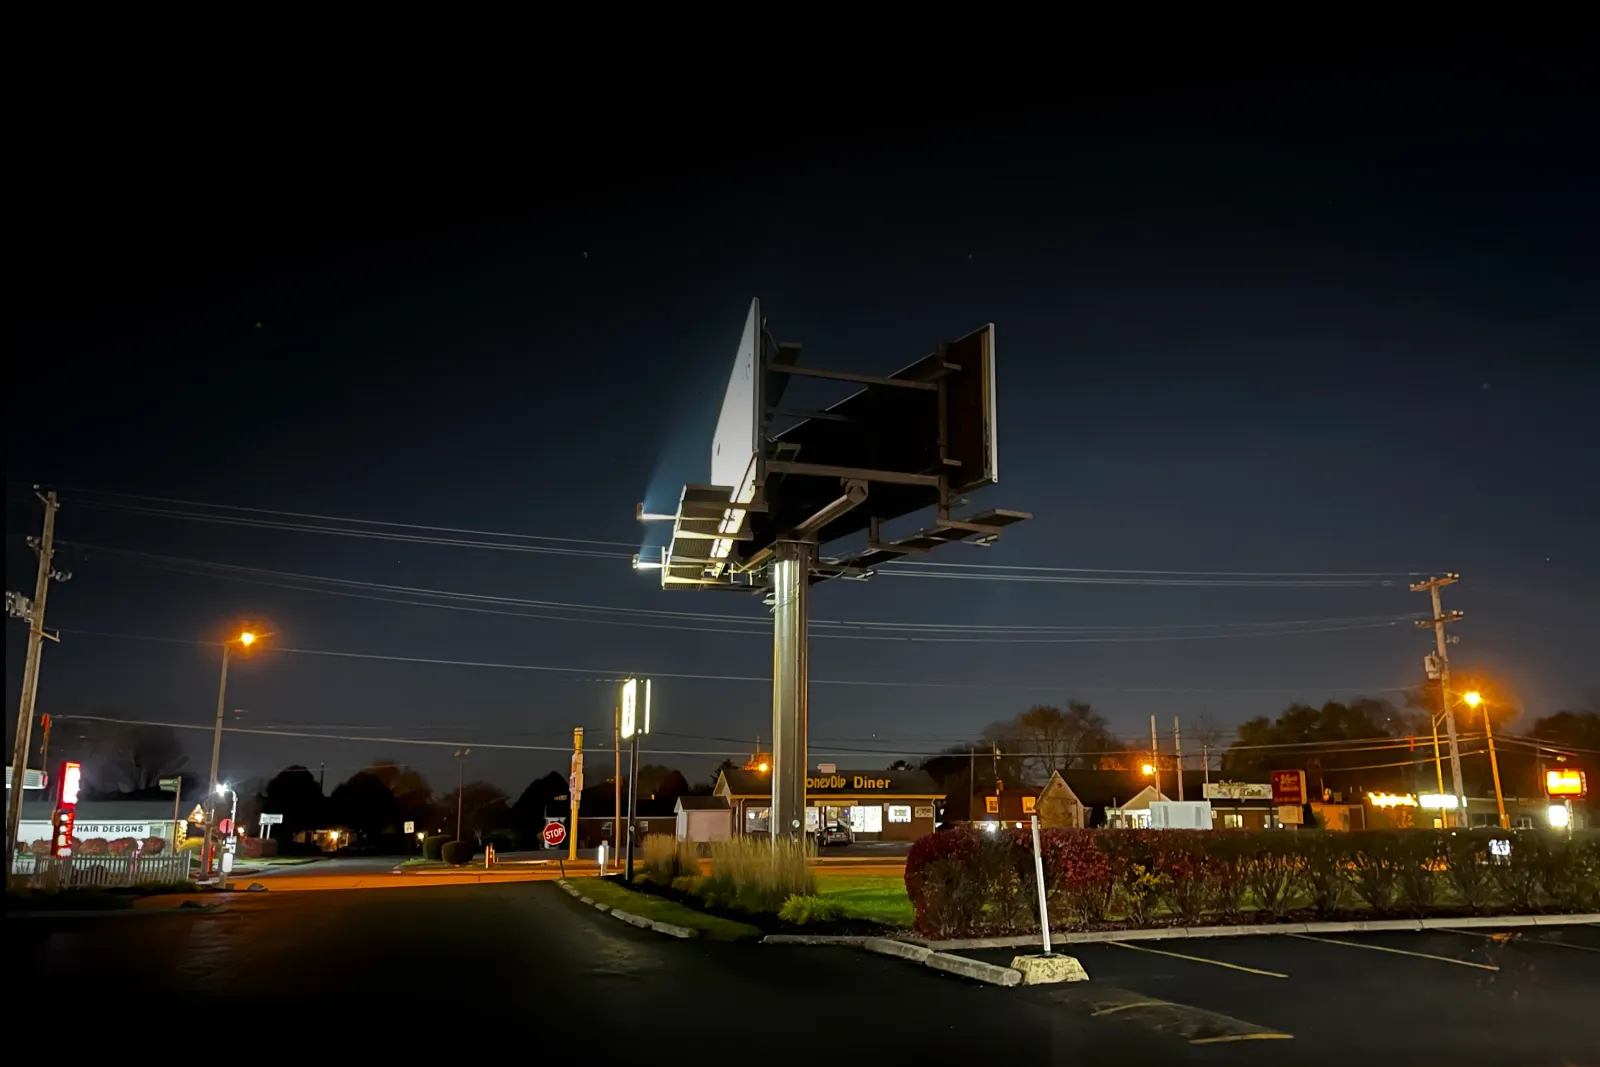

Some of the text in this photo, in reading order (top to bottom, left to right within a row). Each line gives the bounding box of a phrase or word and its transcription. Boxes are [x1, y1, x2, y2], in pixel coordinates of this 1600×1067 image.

[806, 775, 891, 789] oneyDip Diner
[76, 825, 144, 833] HAIR DESIGNS
[545, 827, 563, 840] STOP
